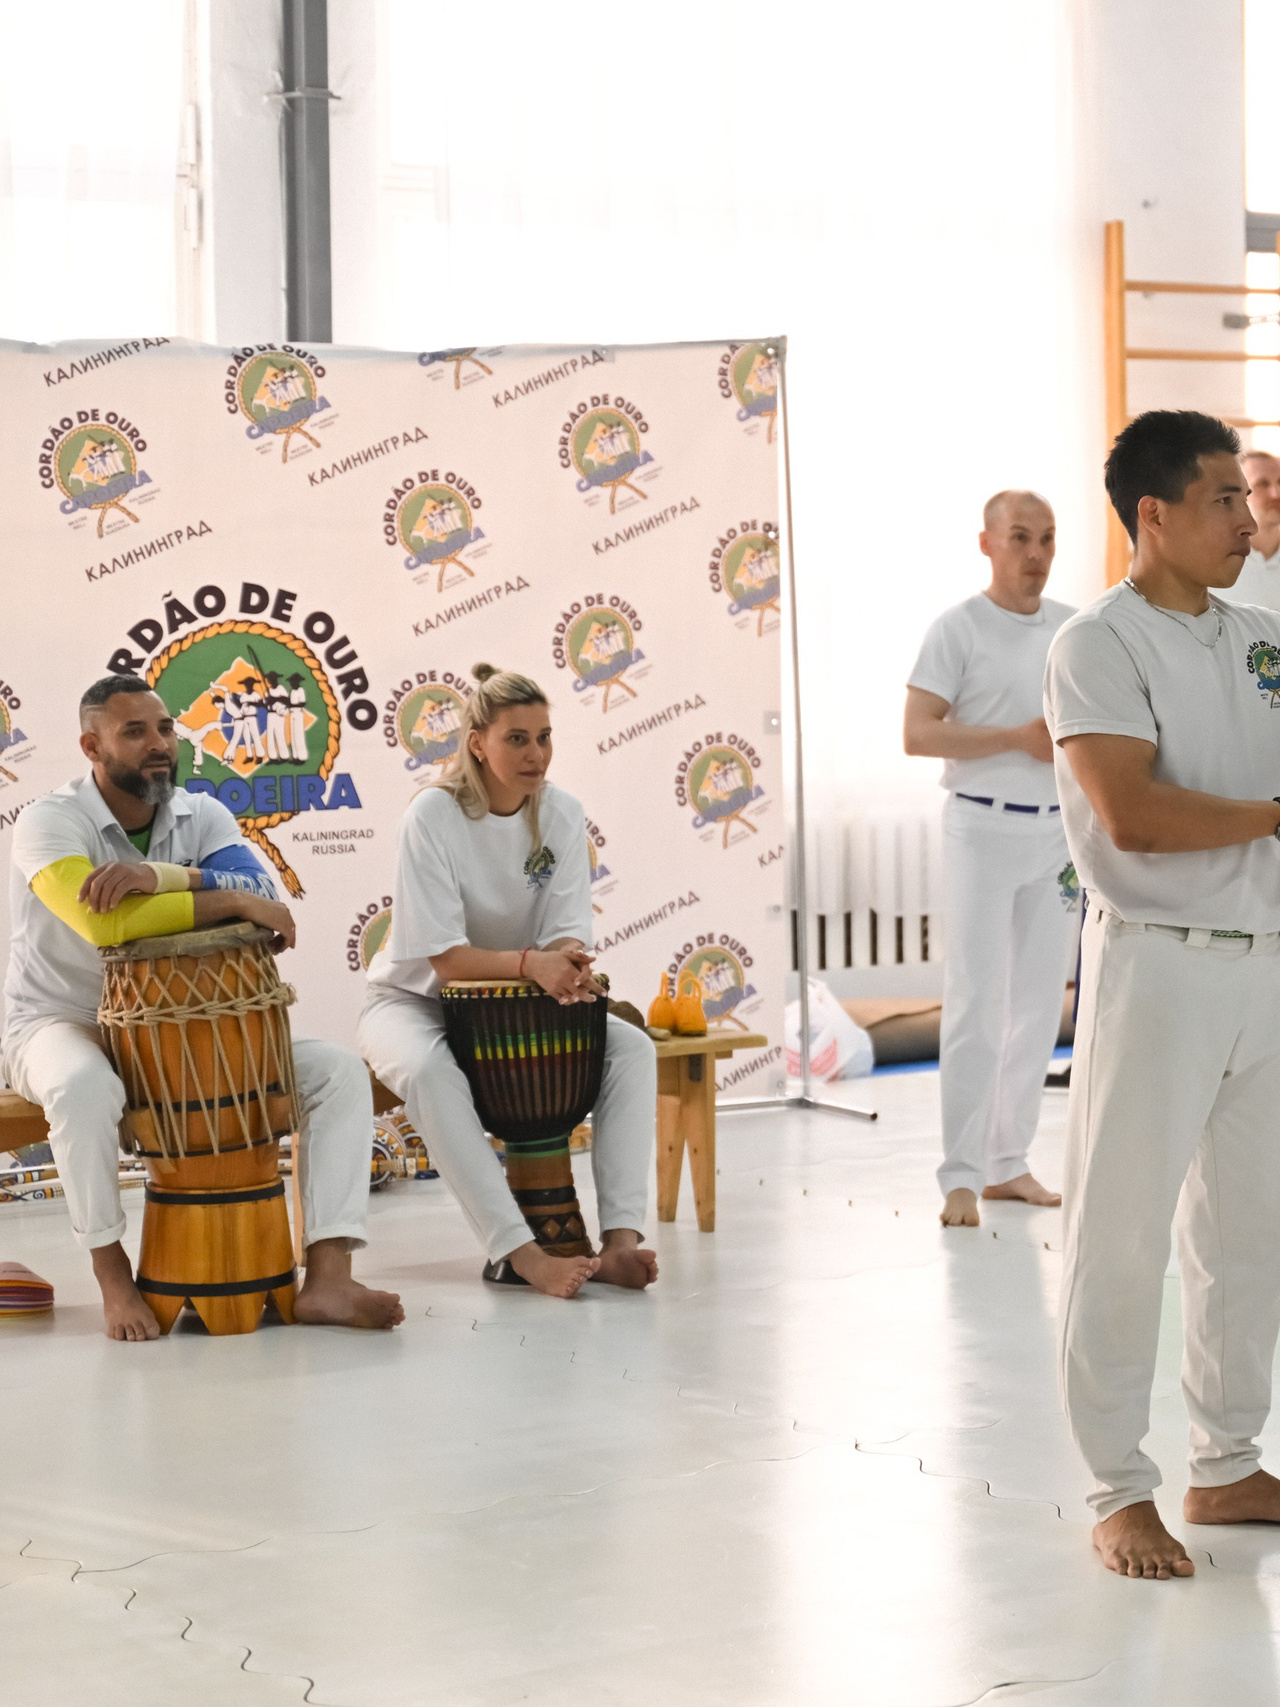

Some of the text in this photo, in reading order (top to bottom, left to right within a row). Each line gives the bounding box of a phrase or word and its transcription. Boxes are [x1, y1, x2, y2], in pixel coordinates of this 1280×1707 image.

[43, 337, 170, 387] КАЛИНИНГРАД
[281, 345, 326, 378] OURO
[492, 349, 604, 407] КАЛИНИНГРАД
[76, 409, 100, 423] DE
[105, 412, 147, 452] OURO
[590, 394, 609, 407] DE
[614, 397, 649, 433] OURO
[307, 427, 428, 486] КАЛИНИНГРАД
[418, 469, 439, 483] DE
[444, 472, 482, 509] OURO
[592, 496, 700, 555] КАЛИНИНГРАД
[740, 519, 757, 532] DE
[85, 520, 213, 582] КАЛИНИНГРАД
[412, 575, 530, 637] КАЛИНИНГРАД
[584, 593, 604, 607] DE
[609, 595, 642, 631] OURO
[106, 582, 378, 731] RDÃO DE OURO
[415, 670, 437, 684] DE
[442, 672, 474, 699] OUR
[597, 694, 706, 755] КАЛИНИНГРАД
[705, 732, 722, 745] DE
[727, 734, 761, 768] OURO
[292, 829, 374, 842] KALININGRAD
[381, 896, 393, 908] D
[594, 890, 700, 954] КАЛИНИНГРАД
[667, 932, 753, 998] ORDÃO DE OURO
[714, 1046, 782, 1092] АЛИНИНГР
